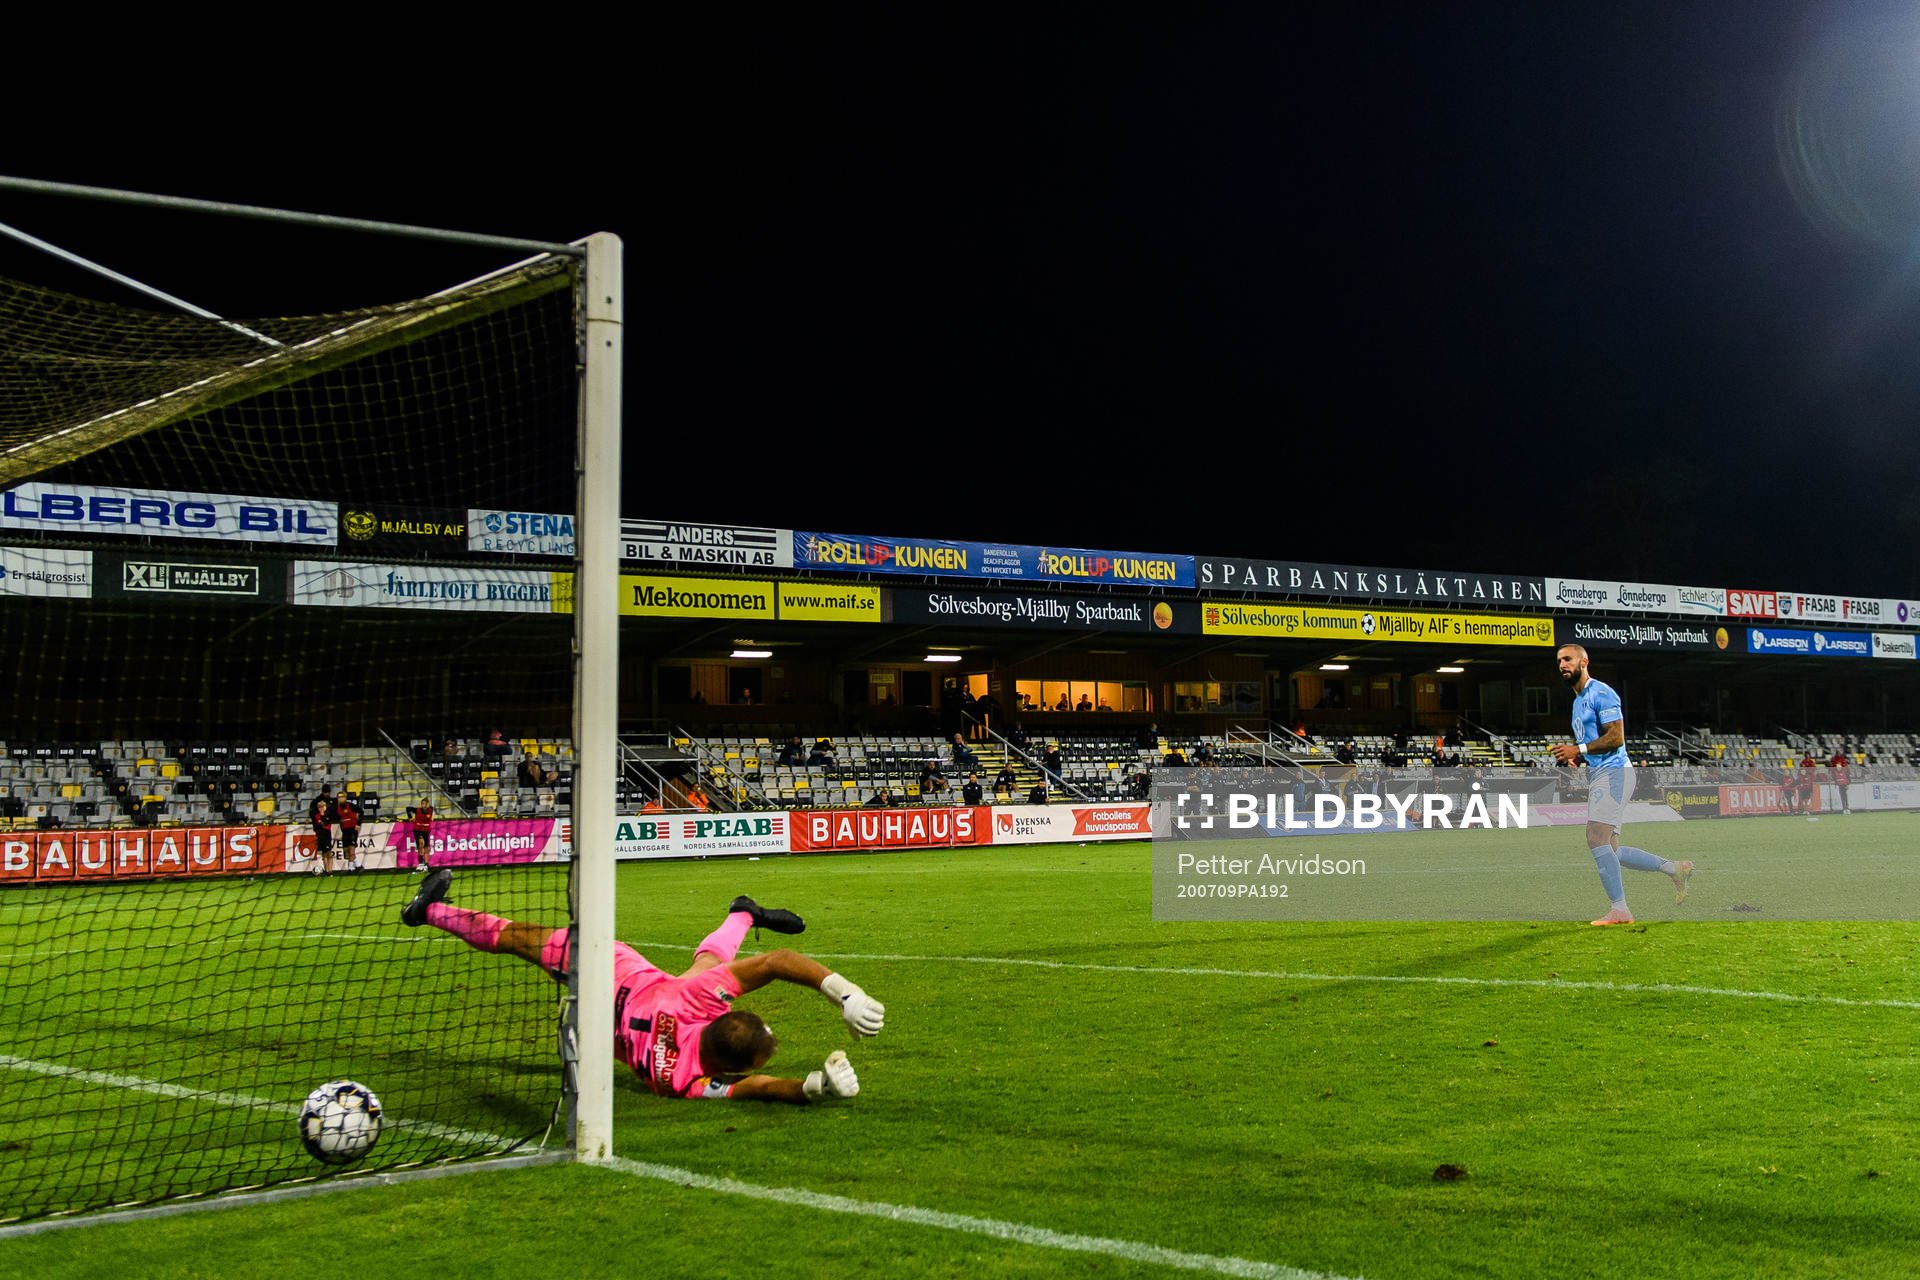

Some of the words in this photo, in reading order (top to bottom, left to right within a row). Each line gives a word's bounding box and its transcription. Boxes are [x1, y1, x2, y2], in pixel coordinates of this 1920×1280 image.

[3, 491, 216, 528] LBERG
[239, 506, 328, 535] BIL
[381, 520, 440, 534] MJÄLLBY
[444, 525, 465, 536] AIF
[505, 513, 574, 537] STENA
[484, 538, 574, 553] RECYCLING
[667, 526, 734, 546] ANDERS
[625, 544, 655, 559] BIL
[661, 547, 673, 559] &
[679, 547, 747, 563] MASKIN
[752, 551, 775, 565] AB
[12, 570, 24, 580] Er
[26, 570, 86, 583] stålgrossist
[127, 564, 165, 587] XL
[174, 571, 249, 587] MJÄLLBY
[1201, 562, 1543, 601] SPARBANKSLÄKTAREN
[486, 583, 549, 601] BYGGER
[632, 586, 767, 610] Mekonomen
[783, 594, 875, 609] www.maif.se
[1556, 581, 1608, 604] Lönneberga
[1617, 585, 1667, 607] Lönneberga
[1678, 588, 1708, 600] TechNet
[1711, 591, 1725, 605] Syd
[928, 594, 1071, 622] Sölvesborg-Mjällby
[1076, 601, 1142, 624] Sparbank
[1805, 597, 1836, 613] FASAB
[1850, 600, 1880, 615] FASAB
[1222, 607, 1300, 633] Sölvesborgs
[1303, 610, 1358, 630] kommun
[1379, 616, 1423, 636] Mjällby
[1464, 620, 1535, 640] hemmaplan
[1575, 623, 1664, 644] Sölvesborg-Mjällby
[1666, 627, 1709, 646] Sparbank
[1764, 638, 1808, 648] LARSSON
[1825, 641, 1867, 650] LARSSON
[1015, 817, 1051, 826] SVENSKA
[1092, 811, 1132, 821] Fotbollens
[616, 822, 657, 840] AB
[695, 818, 773, 838] PEAB
[812, 813, 972, 841] BAUHAUS
[1015, 827, 1035, 835] SPEL
[1085, 821, 1139, 832] huvudsponsor
[4, 834, 254, 872] BAUHAUS
[406, 835, 444, 856] Hja
[447, 833, 535, 853] backlinjen!
